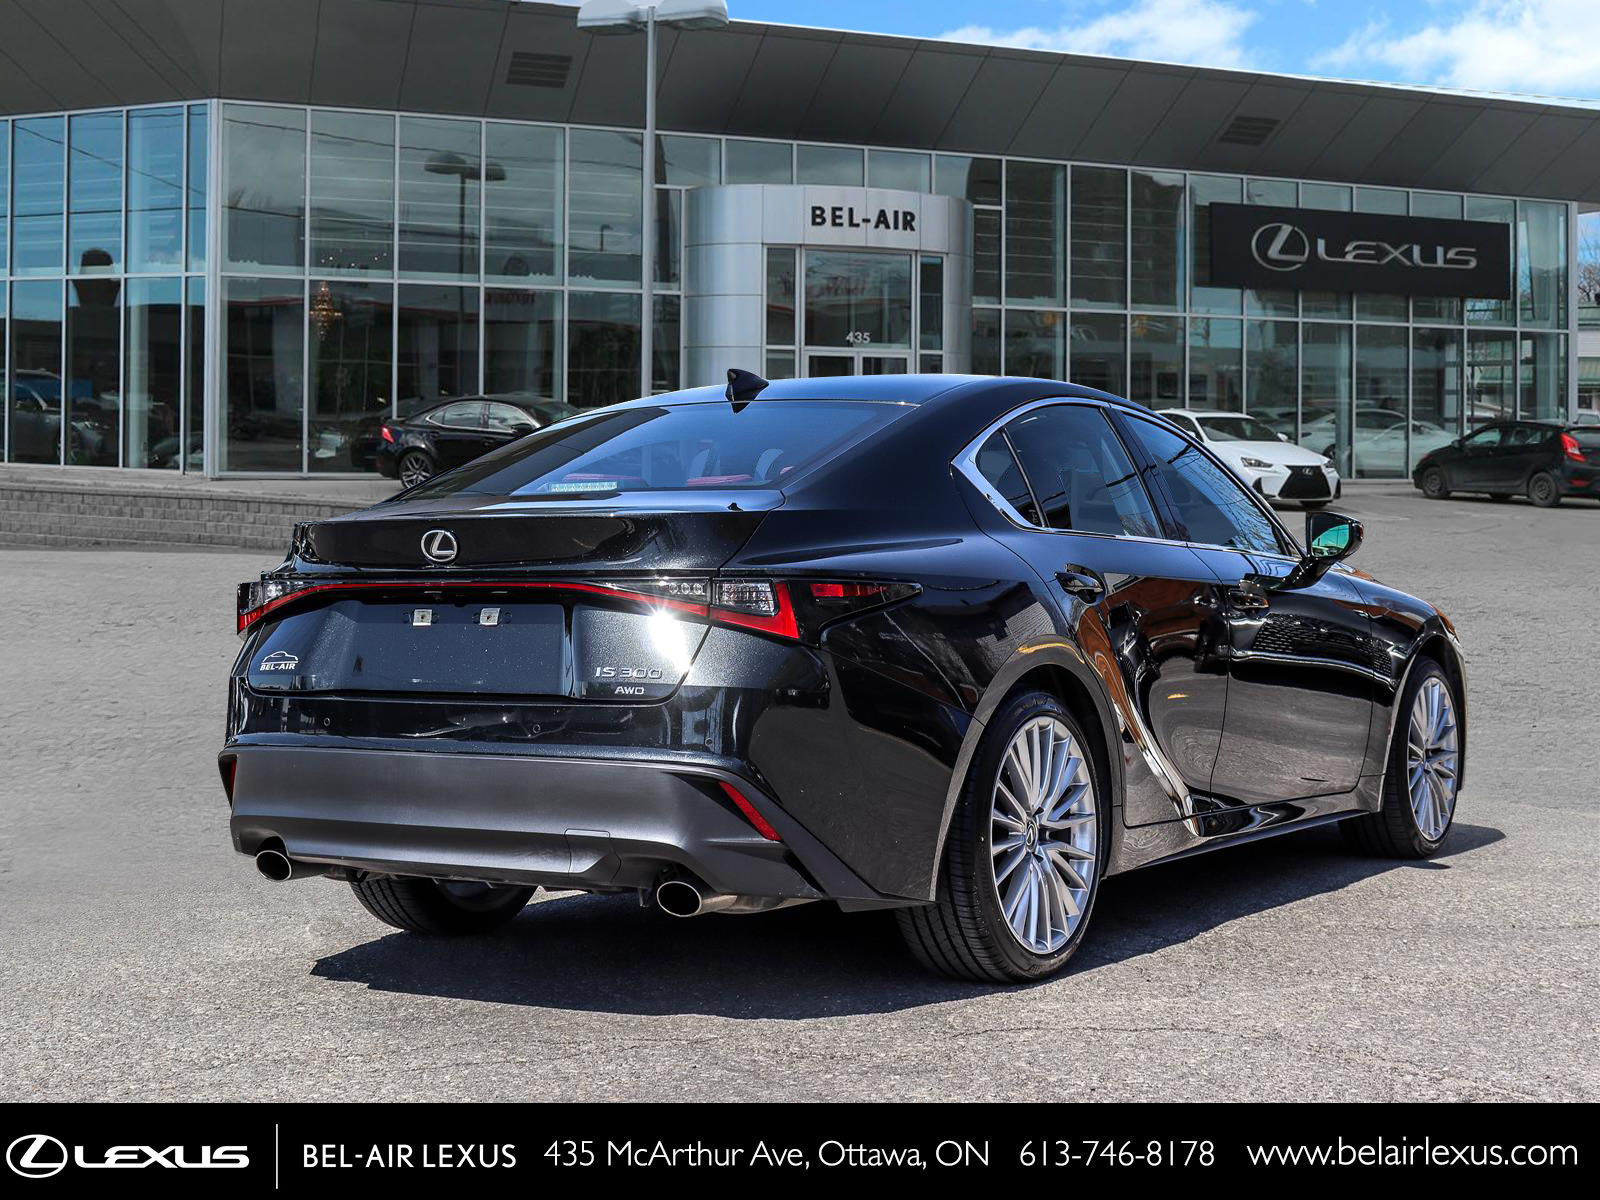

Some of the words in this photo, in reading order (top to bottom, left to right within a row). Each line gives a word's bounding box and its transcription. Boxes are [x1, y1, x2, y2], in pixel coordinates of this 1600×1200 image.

[811, 206, 916, 231] BEL-AIR
[1317, 237, 1478, 269] LEXUS
[845, 331, 871, 344] 435
[260, 663, 296, 671] BEL-AIR
[595, 667, 616, 678] IS
[619, 668, 663, 679] 300
[614, 686, 645, 695] AWD
